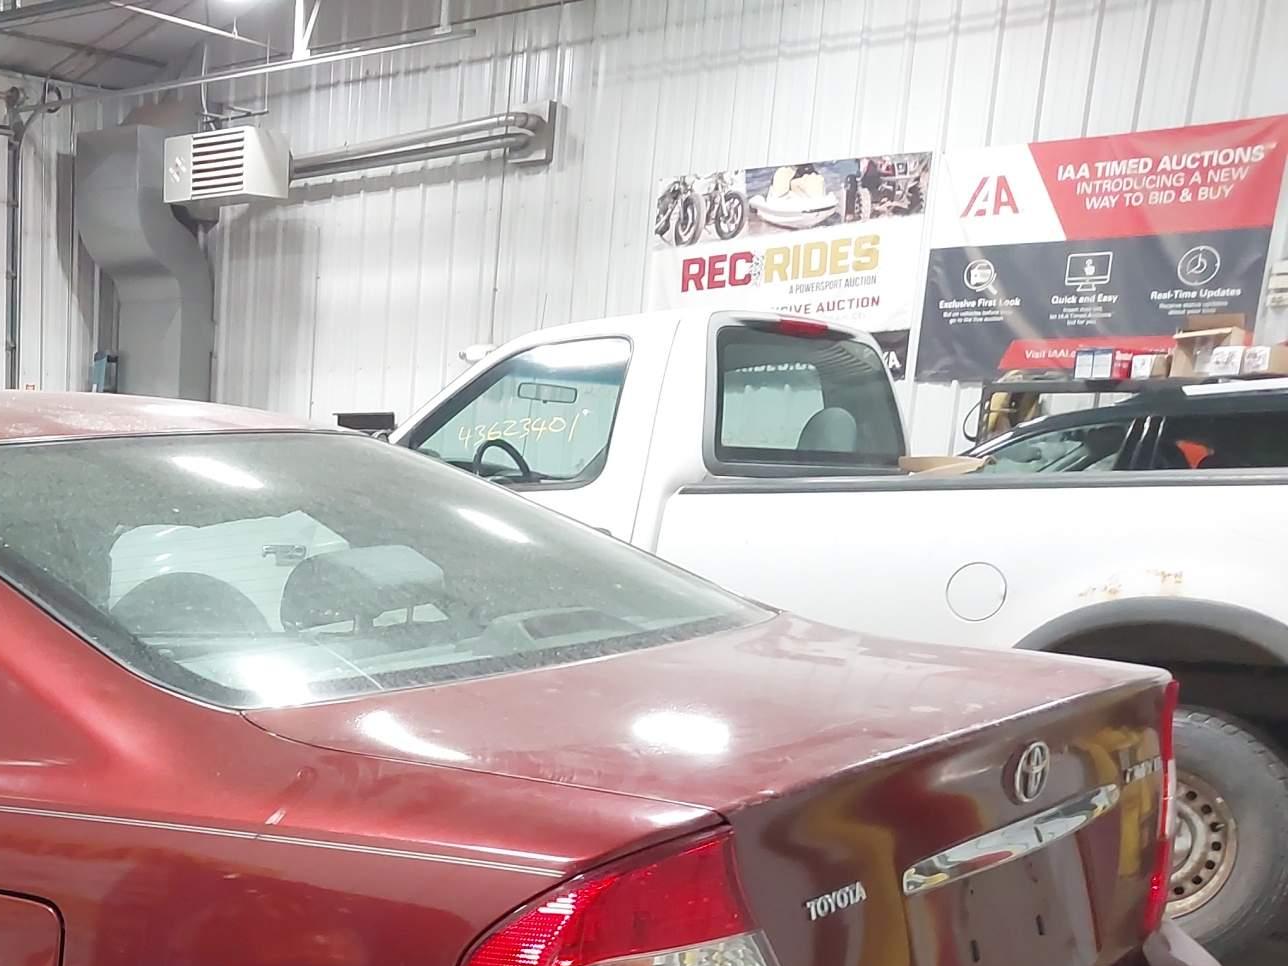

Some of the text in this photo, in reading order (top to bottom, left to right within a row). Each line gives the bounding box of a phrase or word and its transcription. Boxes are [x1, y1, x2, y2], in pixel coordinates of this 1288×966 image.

[1094, 158, 1153, 178] TIMED
[1076, 166, 1251, 195] INTRODUCING A NEW
[1084, 184, 1235, 210] WAY TO BID & BUY
[795, 278, 843, 295] POWERSPORT
[844, 275, 878, 289] AUCTION
[1150, 287, 1242, 300] Real-Time Updates
[816, 296, 880, 313] AUCTION
[939, 299, 977, 309] Exclusive
[977, 298, 997, 307] First
[1051, 293, 1119, 304] Quick and Easy
[1025, 349, 1045, 359] Visit
[458, 412, 581, 449] 43623401
[805, 881, 868, 921] TOYOTA
